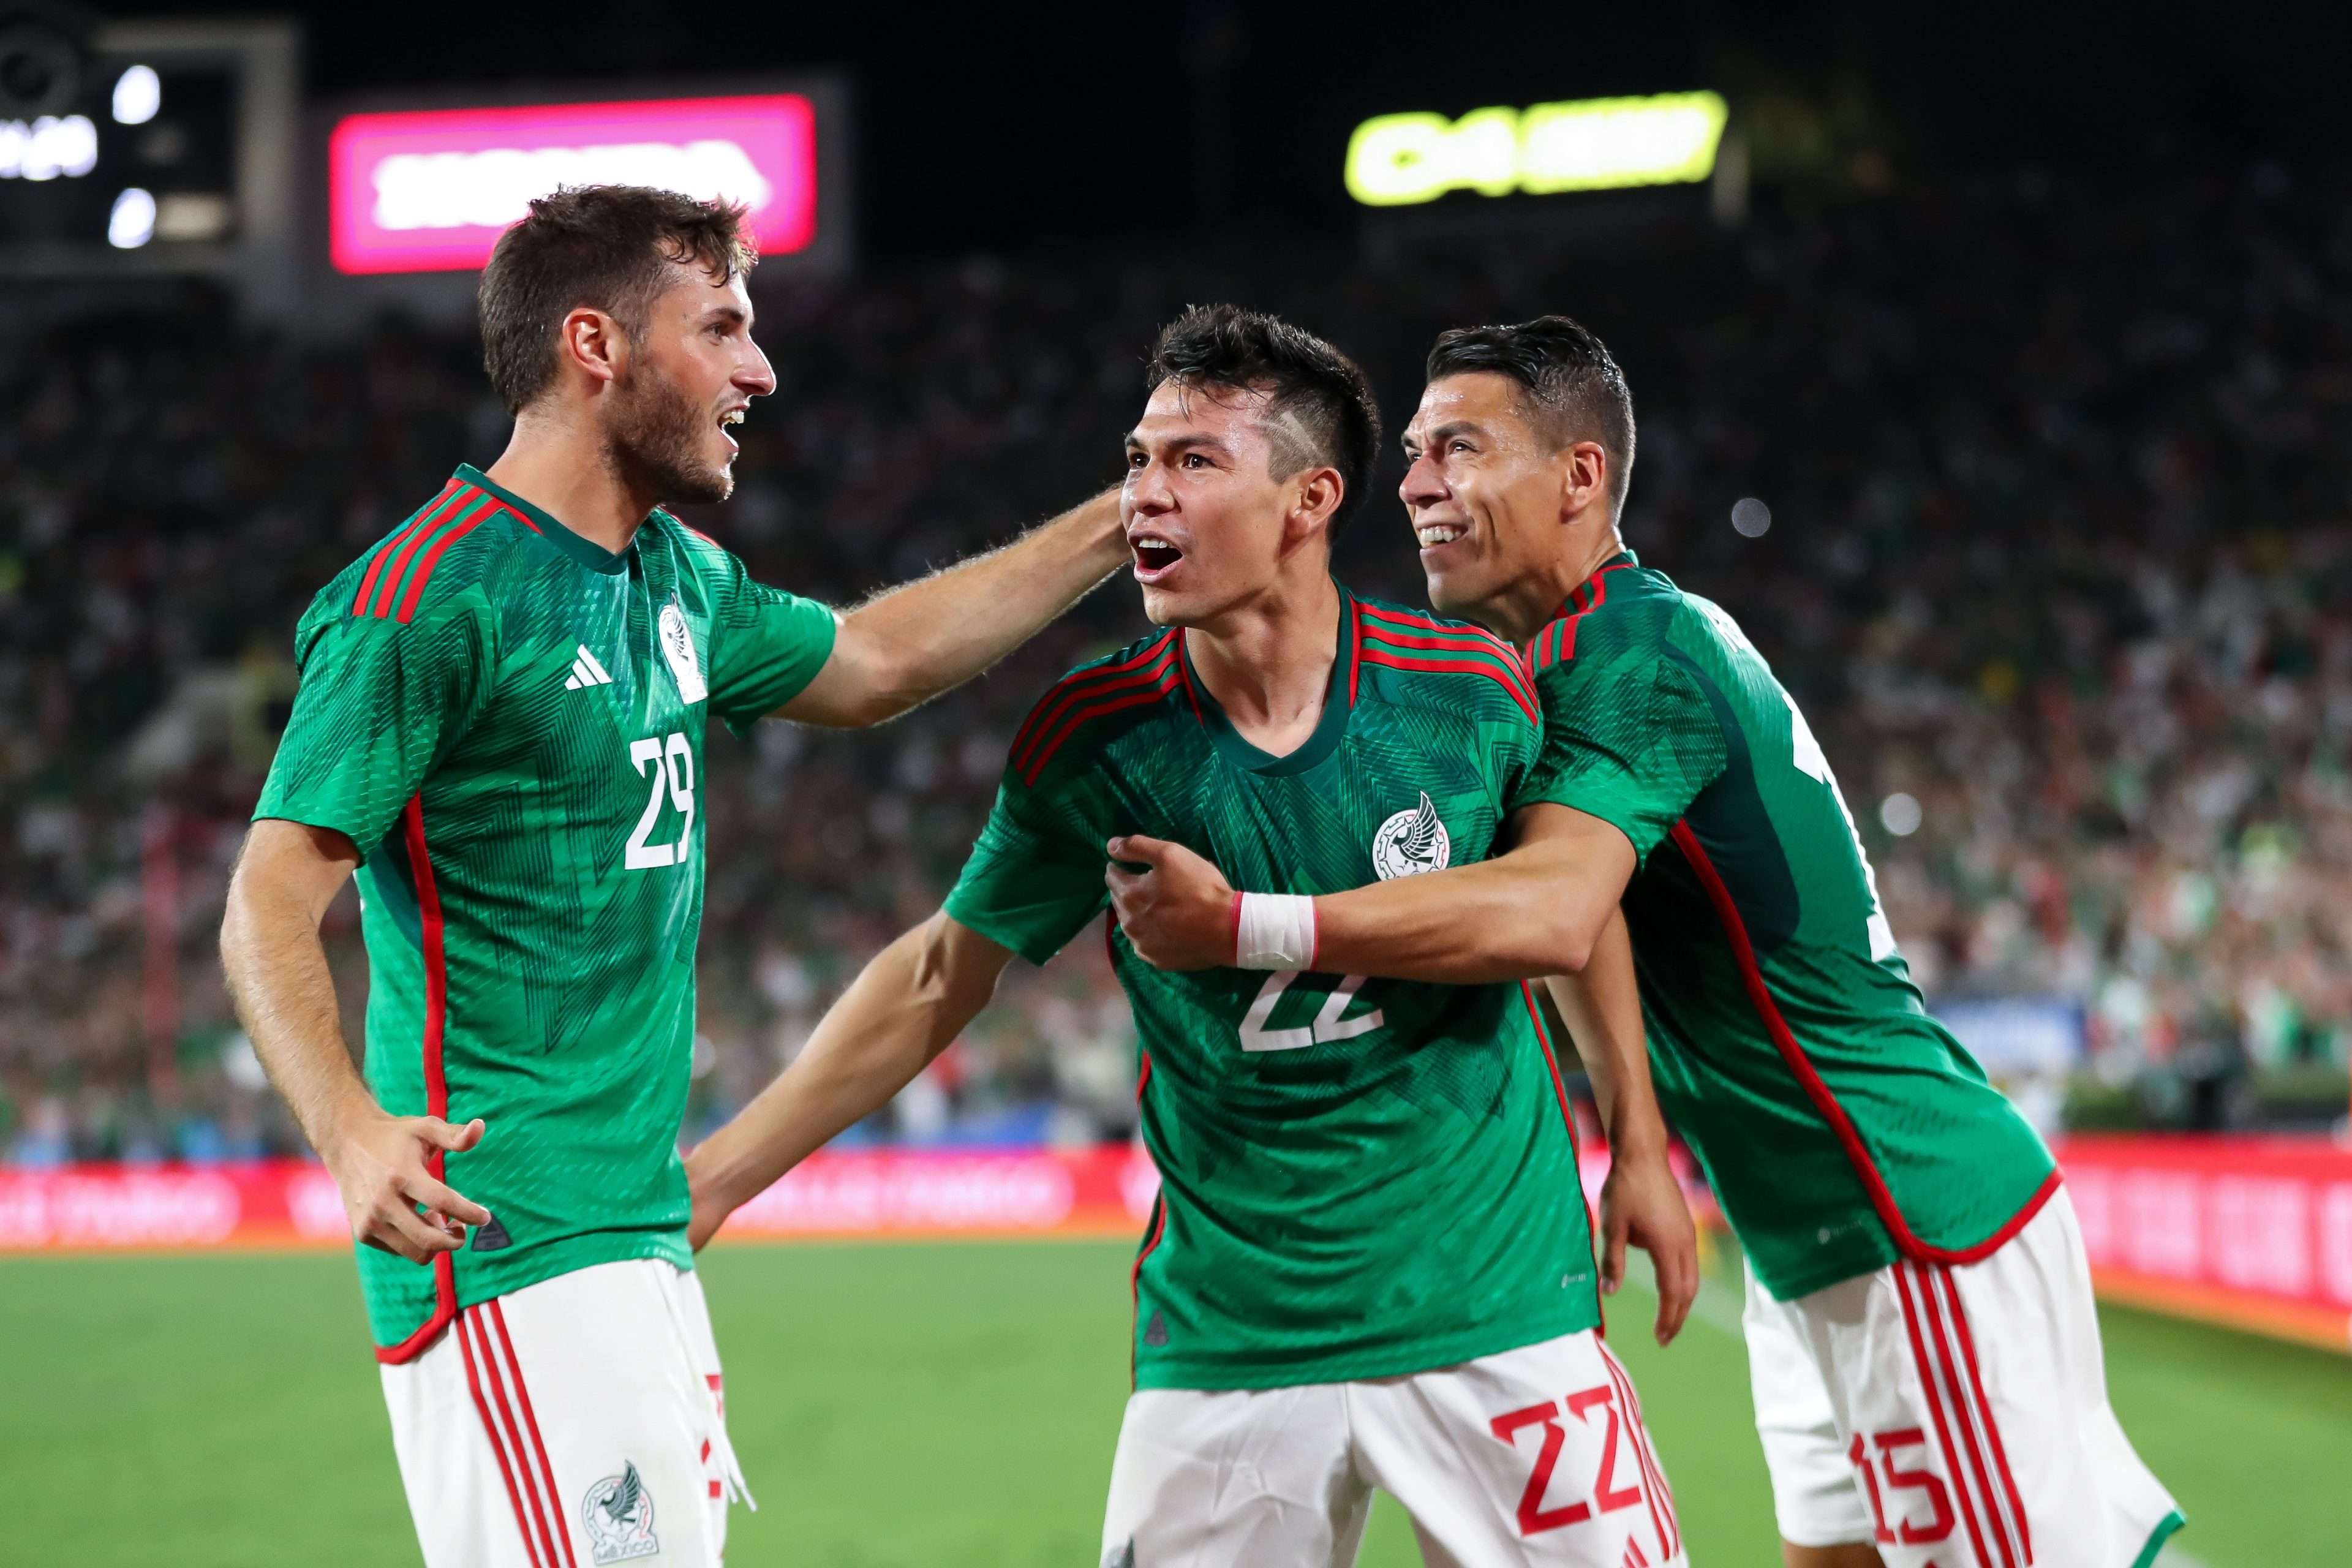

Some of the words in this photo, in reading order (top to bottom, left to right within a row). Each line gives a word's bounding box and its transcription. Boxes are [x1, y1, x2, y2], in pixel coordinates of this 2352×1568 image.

[624, 733, 694, 870] 29
[1490, 1385, 1642, 1537] 22
[1849, 1428, 1956, 1544] 15
